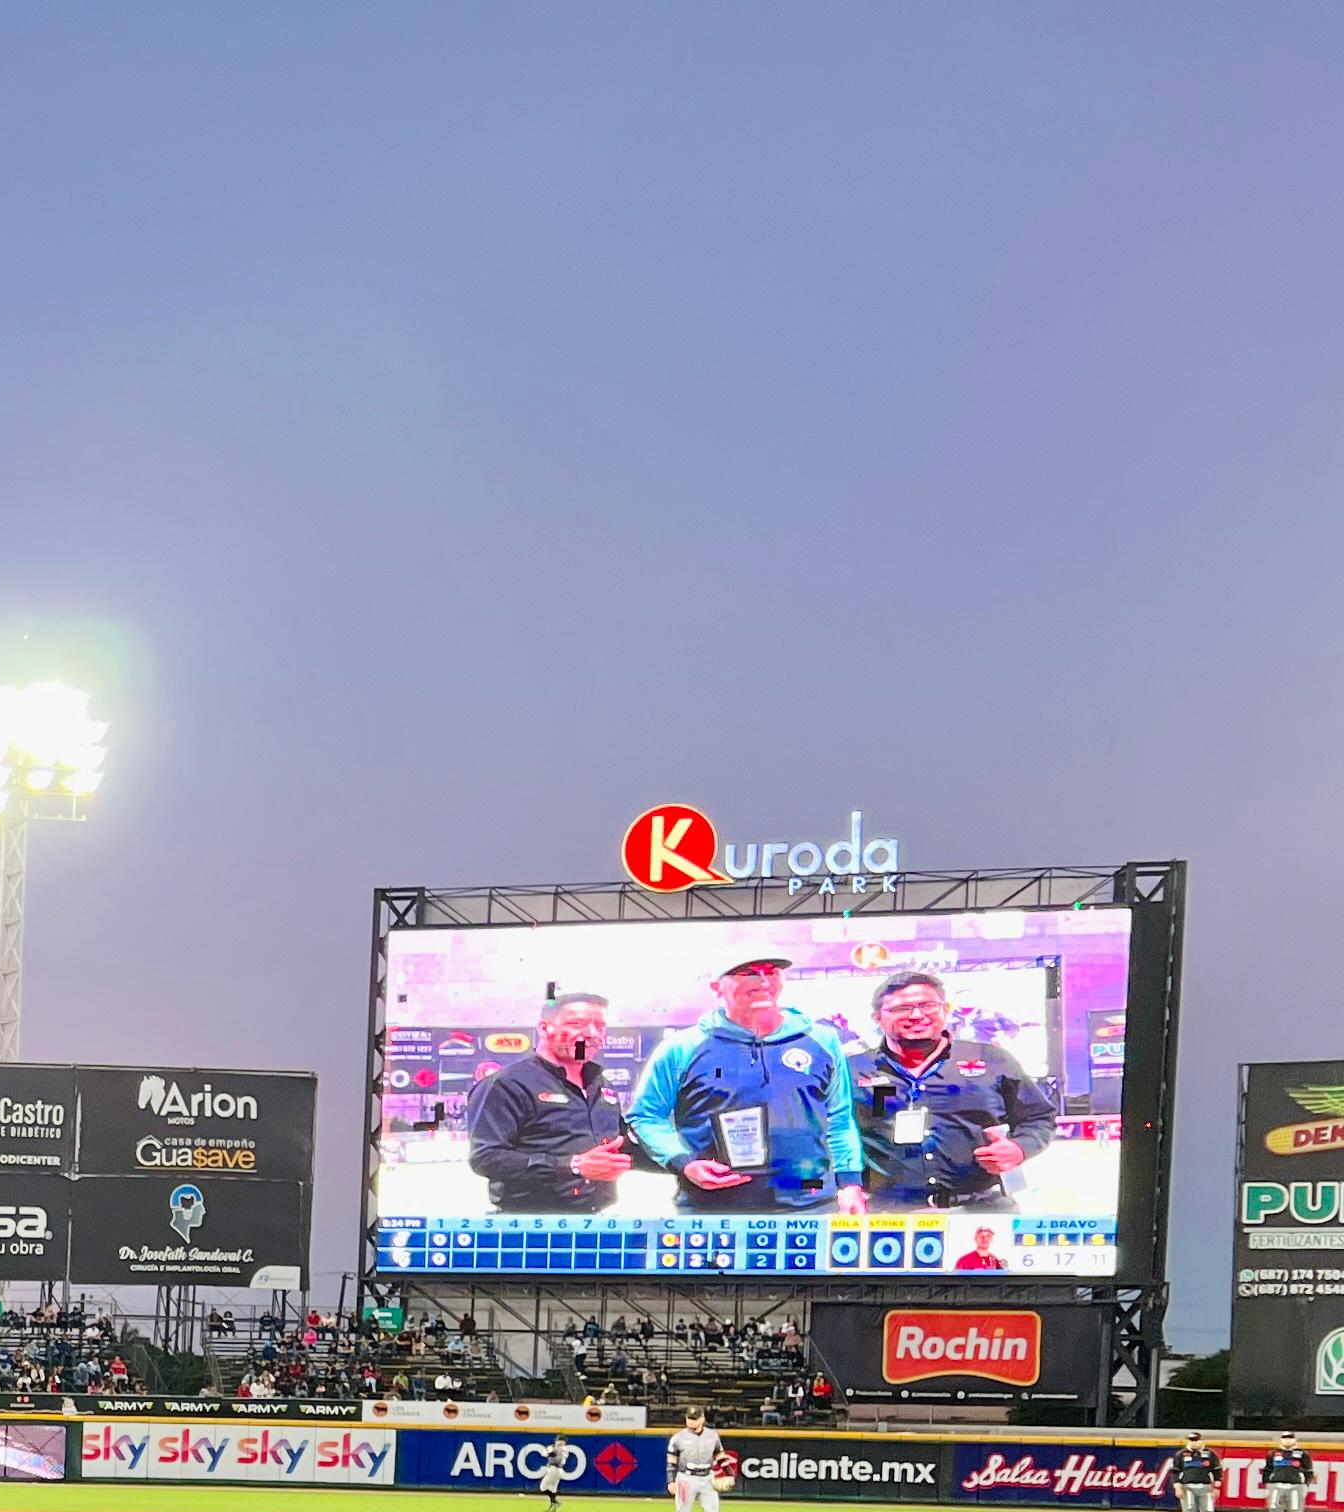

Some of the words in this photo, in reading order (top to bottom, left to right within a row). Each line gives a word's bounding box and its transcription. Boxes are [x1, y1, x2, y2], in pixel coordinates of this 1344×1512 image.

[650, 809, 899, 882] Kuroda
[788, 875, 898, 895] PARK
[160, 1081, 258, 1119] Arion
[0, 1097, 65, 1126] Castro
[10, 1125, 62, 1139] DIABÉTICO
[164, 1138, 192, 1146] casa
[194, 1137, 206, 1146] de
[208, 1138, 256, 1149] empeño
[1241, 1181, 1344, 1225] PU
[461, 1219, 470, 1228] 2
[484, 1219, 494, 1229] 3
[509, 1219, 519, 1229] 4
[534, 1219, 543, 1229] 5
[558, 1219, 567, 1229] 6
[583, 1219, 592, 1229] 7
[607, 1219, 616, 1229] 8
[633, 1219, 642, 1229] 9
[664, 1219, 675, 1229] C
[691, 1219, 703, 1229] H
[720, 1219, 730, 1229] E
[748, 1220, 777, 1229] LOB
[786, 1220, 819, 1229] MVR
[869, 1220, 905, 1228] STRIKE
[1050, 1220, 1098, 1229] BRAVO
[9, 1241, 44, 1255] obra
[757, 1234, 768, 1247] 0
[795, 1234, 808, 1247] 0
[831, 1236, 861, 1264] 0
[873, 1236, 900, 1264] 0
[915, 1236, 943, 1263] 0
[757, 1255, 767, 1267] 2
[795, 1255, 807, 1267] 0
[1023, 1253, 1034, 1267] 6
[1054, 1253, 1075, 1266] 17
[895, 1325, 1028, 1361] Rochin
[102, 1400, 148, 1412] ARMY
[170, 1401, 215, 1413] ARMY
[237, 1403, 282, 1414] ARMY
[305, 1404, 351, 1416] ARMY
[82, 1425, 151, 1470] sky
[158, 1428, 230, 1473] sky
[237, 1429, 310, 1474] sky
[317, 1433, 392, 1478] sky
[450, 1441, 587, 1481] ARCO
[741, 1452, 936, 1484] caliente.mx
[963, 1453, 1050, 1489] Salsa
[1054, 1453, 1174, 1496] Huichol
